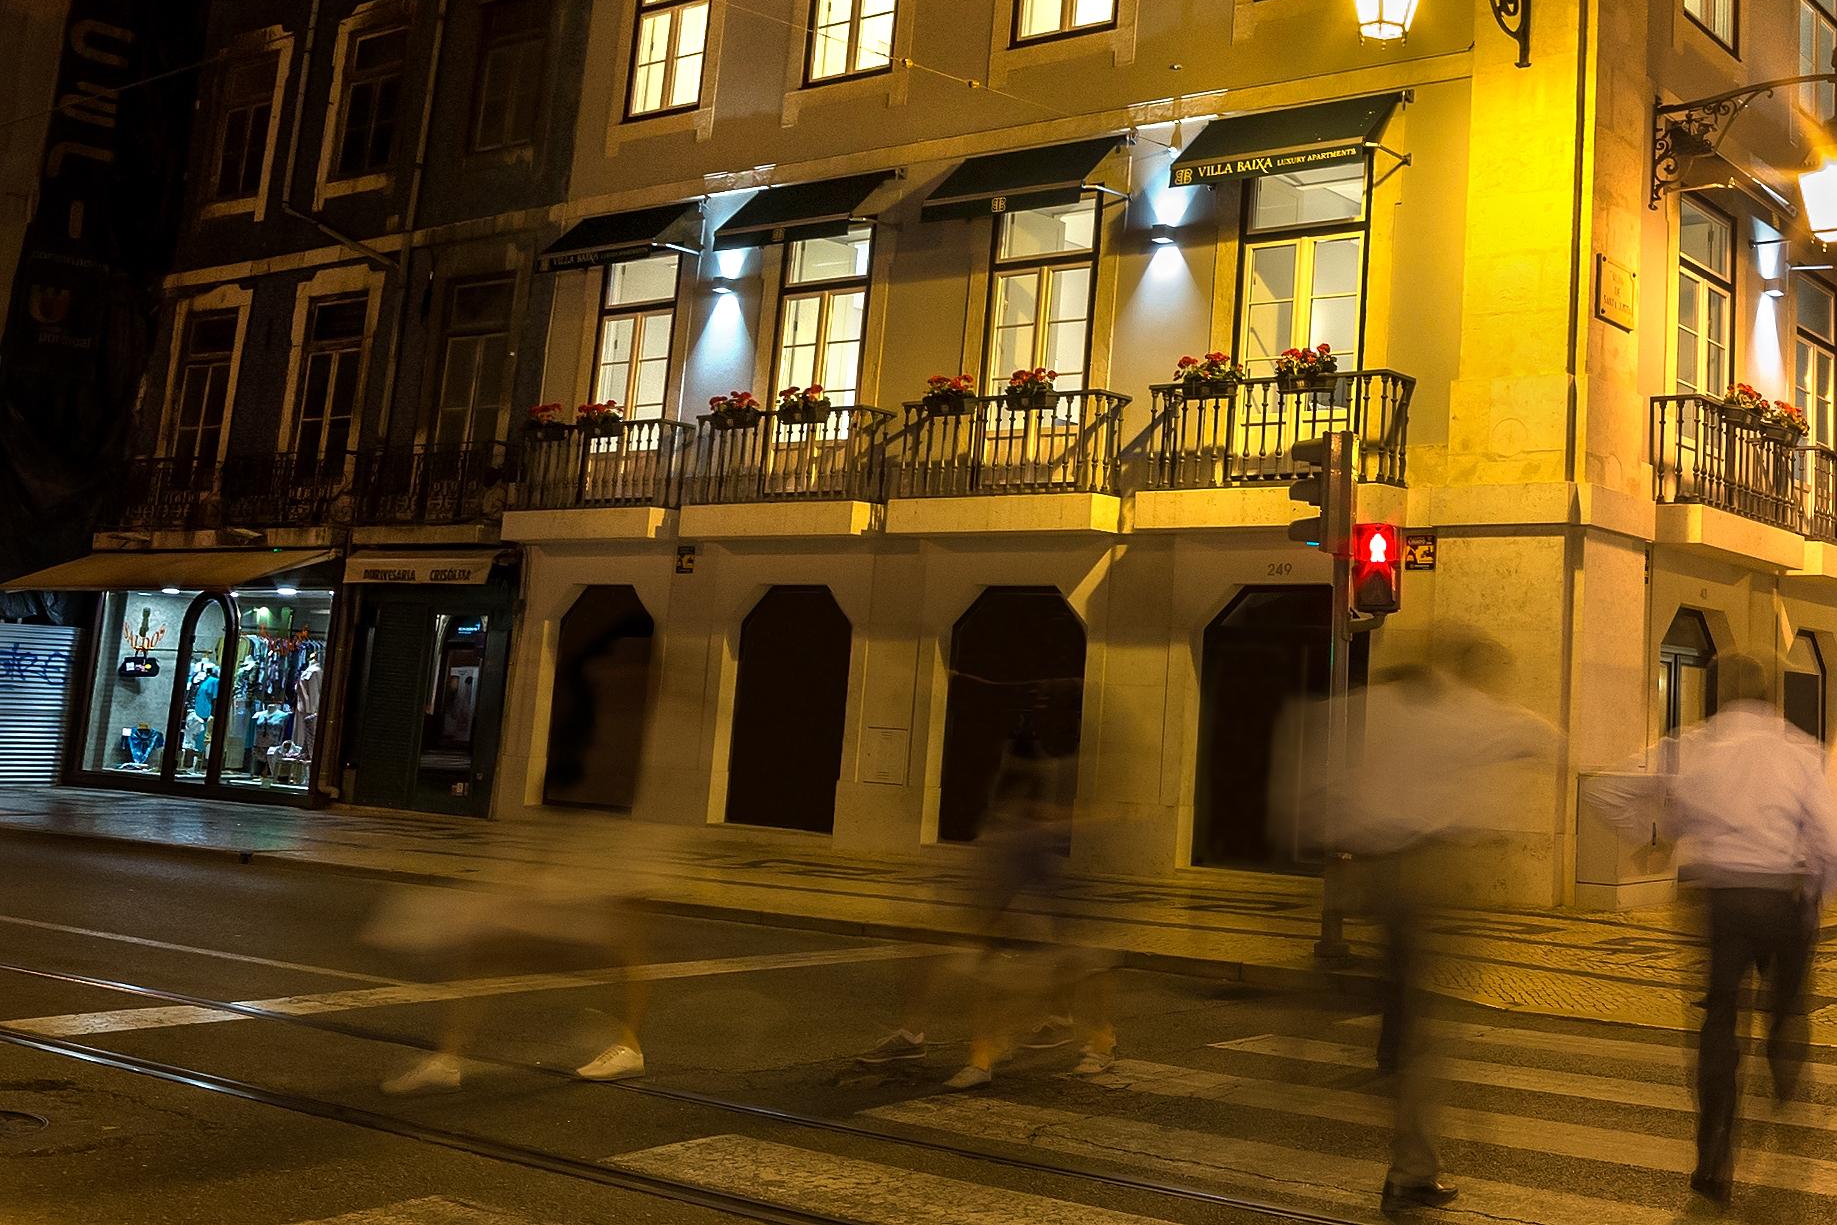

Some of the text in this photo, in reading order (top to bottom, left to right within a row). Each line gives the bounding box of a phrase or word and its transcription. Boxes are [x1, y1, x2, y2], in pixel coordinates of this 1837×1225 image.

[1198, 147, 1357, 178] VILLA BAIXA LUXURY APARTMENTS
[1267, 563, 1293, 577] 249
